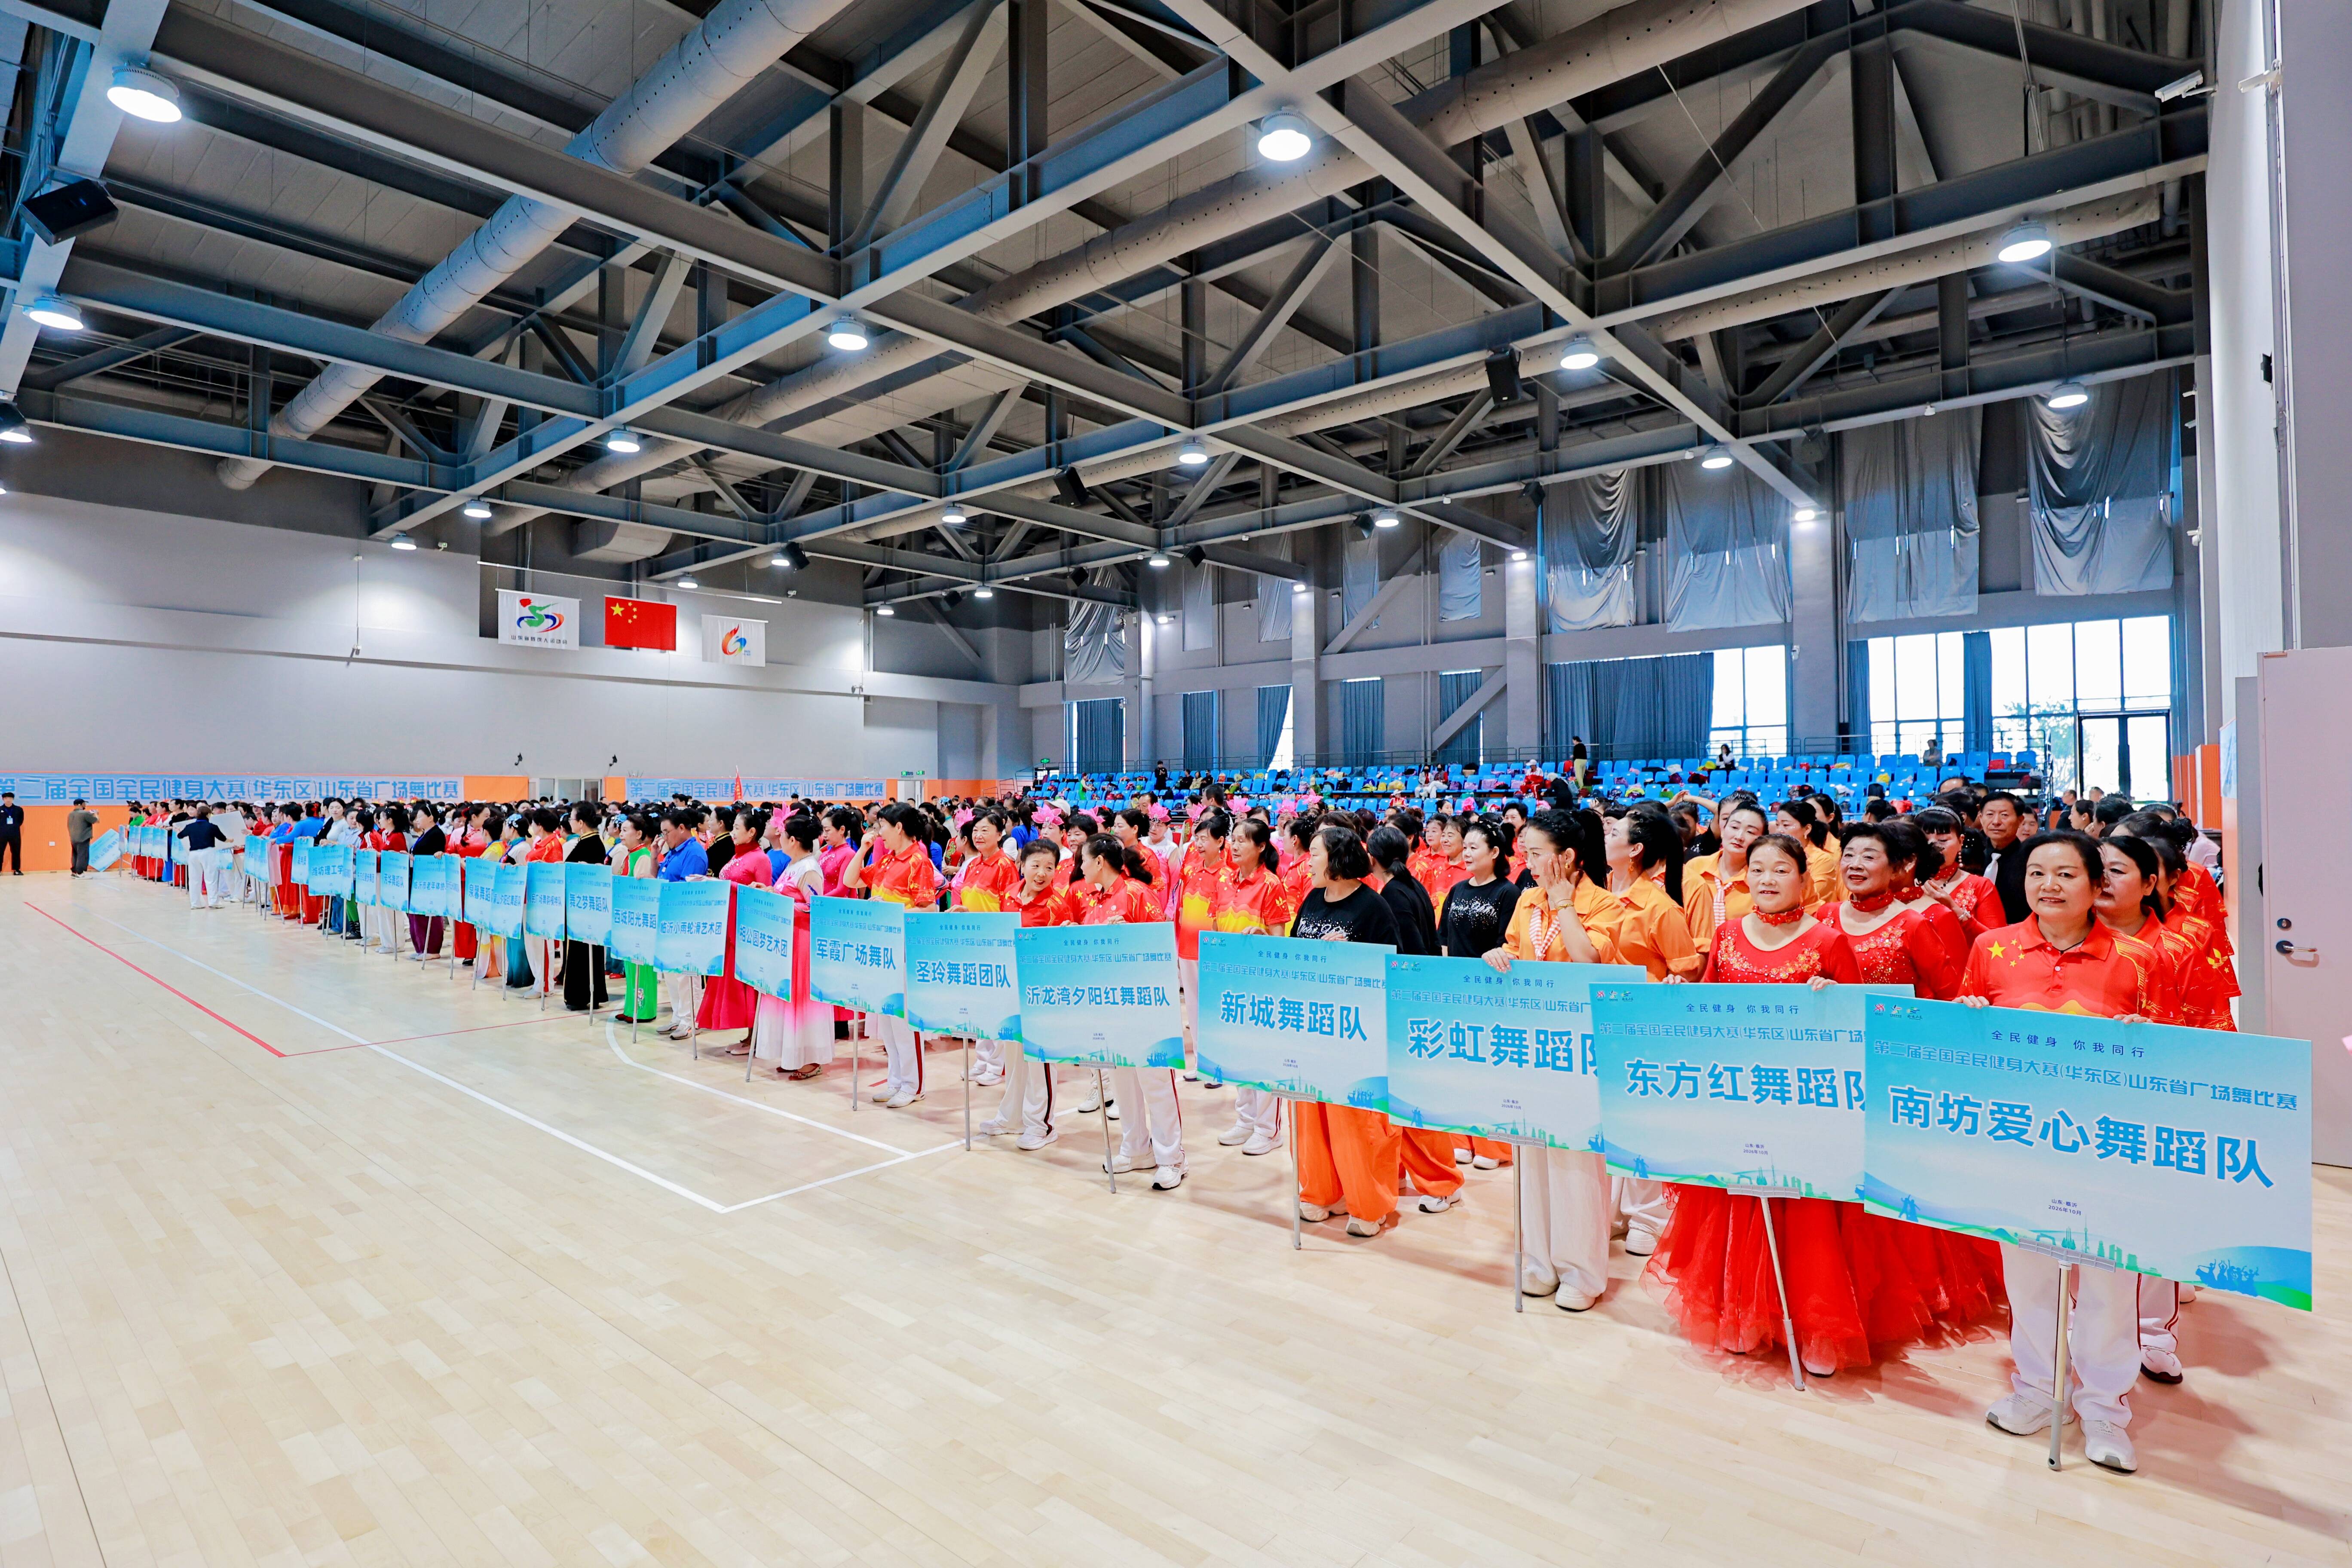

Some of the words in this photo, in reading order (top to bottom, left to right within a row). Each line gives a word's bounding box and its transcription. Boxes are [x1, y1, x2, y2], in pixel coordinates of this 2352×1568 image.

[570, 893, 609, 913] 舞之梦舞蹈队
[614, 909, 657, 929] 西城阳光舞蹈
[660, 922, 723, 935] 临沂小雨轮滑艺术团
[740, 925, 787, 958] 相公圆梦艺术团
[817, 938, 896, 970] 军霞广场舞队
[1258, 950, 1289, 960] 全民健身
[1295, 953, 1327, 963] 你我同行
[916, 960, 1011, 989] 圣玲舞蹈团队
[1463, 975, 1503, 985] 全民健身
[1512, 977, 1555, 988] 你我同行
[1026, 986, 1170, 1007] 沂龙湾夕阳红舞蹈队
[1220, 991, 1368, 1042] 新城舞蹈队
[1686, 1003, 1736, 1014] 全民健身
[1746, 1004, 1799, 1015] 你我同行
[1991, 1030, 2058, 1047] 全民健身
[2073, 1039, 2145, 1059] 你我同行
[1874, 1040, 2298, 1111] 第二届全国全民健身大赛(华东区)山东省广场舞比赛
[1890, 1086, 2275, 1189] 南坊爱心舞蹈队
[2048, 1204, 2082, 1216] 2026年10月
